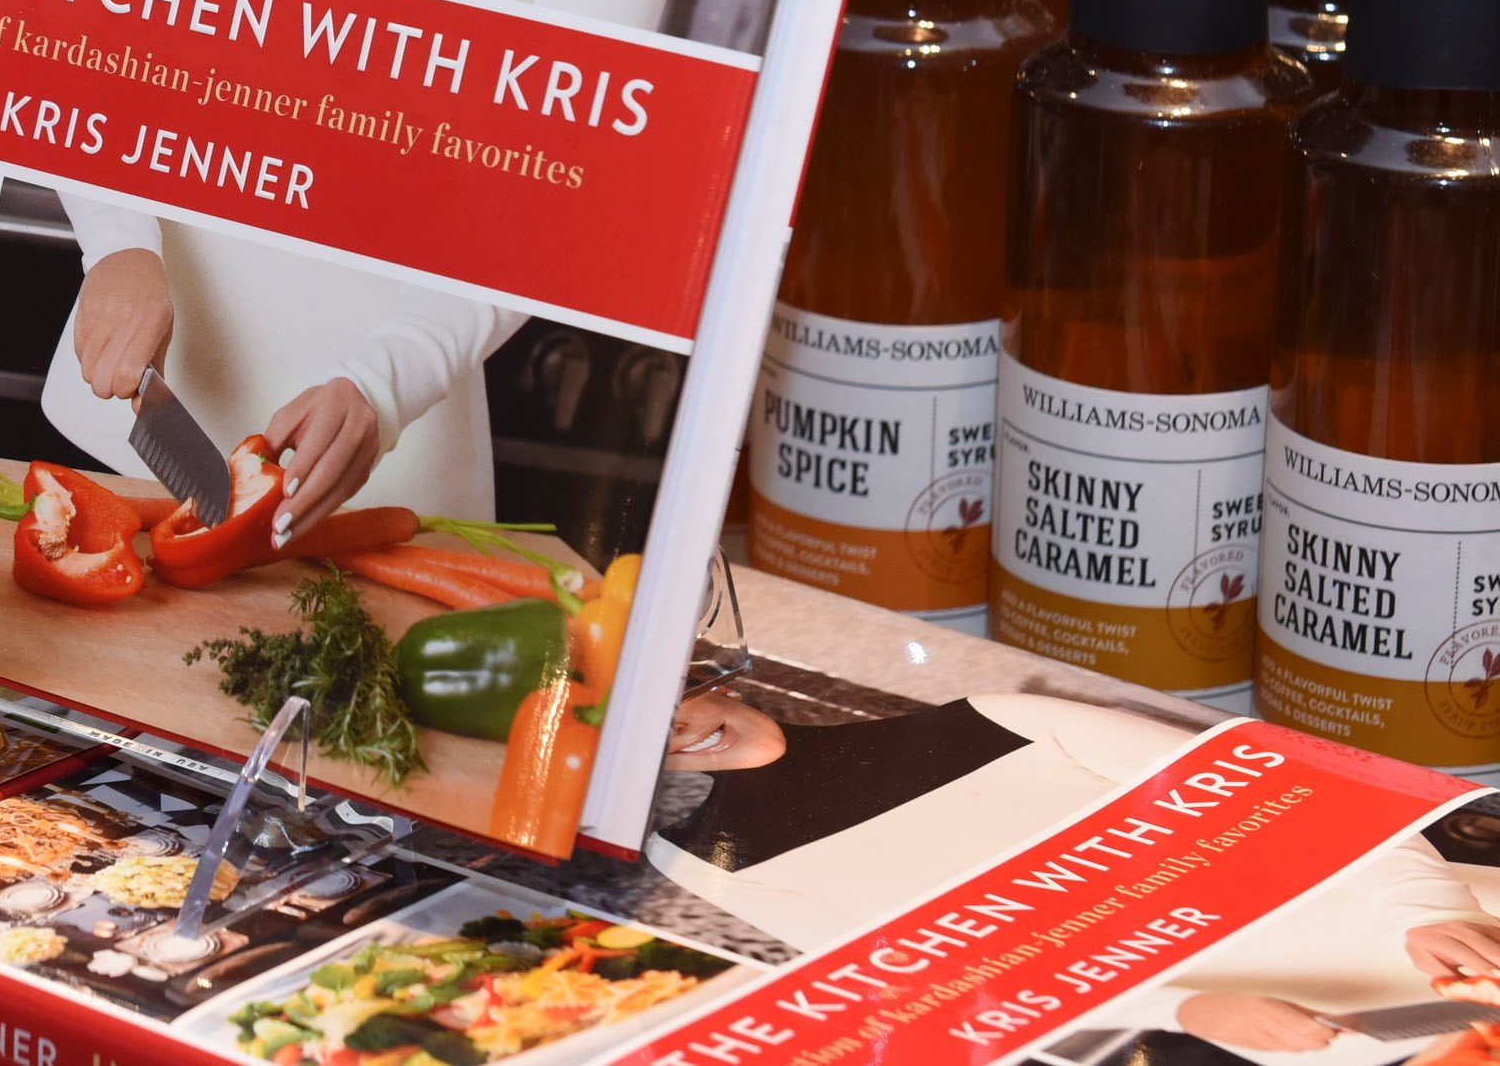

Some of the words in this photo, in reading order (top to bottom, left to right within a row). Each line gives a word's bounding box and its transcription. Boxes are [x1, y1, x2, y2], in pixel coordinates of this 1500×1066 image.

[301, 2, 472, 94] WITH
[493, 49, 655, 137] KRIS
[13, 19, 308, 124] kardashian-jenner
[315, 92, 424, 155] family
[430, 121, 585, 190] favorites
[0, 92, 106, 156] KRIS
[121, 125, 315, 211] JENNER
[771, 314, 998, 362] WILLIAMS-SONOMA
[764, 389, 900, 455] PUMPKIN
[1023, 384, 1262, 434] WILLIAMS-SONOMA
[778, 443, 869, 497] SPICE
[1027, 459, 1145, 513] SKINNY
[1025, 497, 1140, 549] SALTED
[1015, 529, 1157, 588] CARAMEL
[1287, 524, 1401, 582] SKINNY
[1284, 560, 1396, 619] SALTED
[1053, 629, 1129, 655] COCKTAILS,
[1098, 622, 1138, 638] TWIST
[1274, 593, 1413, 660] CARAMEL
[1283, 669, 1349, 703] FLAVORFUL
[1353, 693, 1393, 711] TWIST
[1309, 697, 1385, 729] COCKTAILS,
[1292, 711, 1351, 737] DESSERTS
[650, 1016, 795, 1066] THE
[776, 893, 1036, 1021] KITCHEN
[1013, 817, 1174, 892] WITH
[1154, 744, 1285, 817] KRIS
[858, 1016, 894, 1039] of
[878, 895, 1126, 1025] kardashian-jenner
[1115, 848, 1212, 900] family
[1196, 784, 1314, 854] favorites
[949, 989, 1062, 1047] KRIS
[1054, 906, 1222, 995] JENNER
